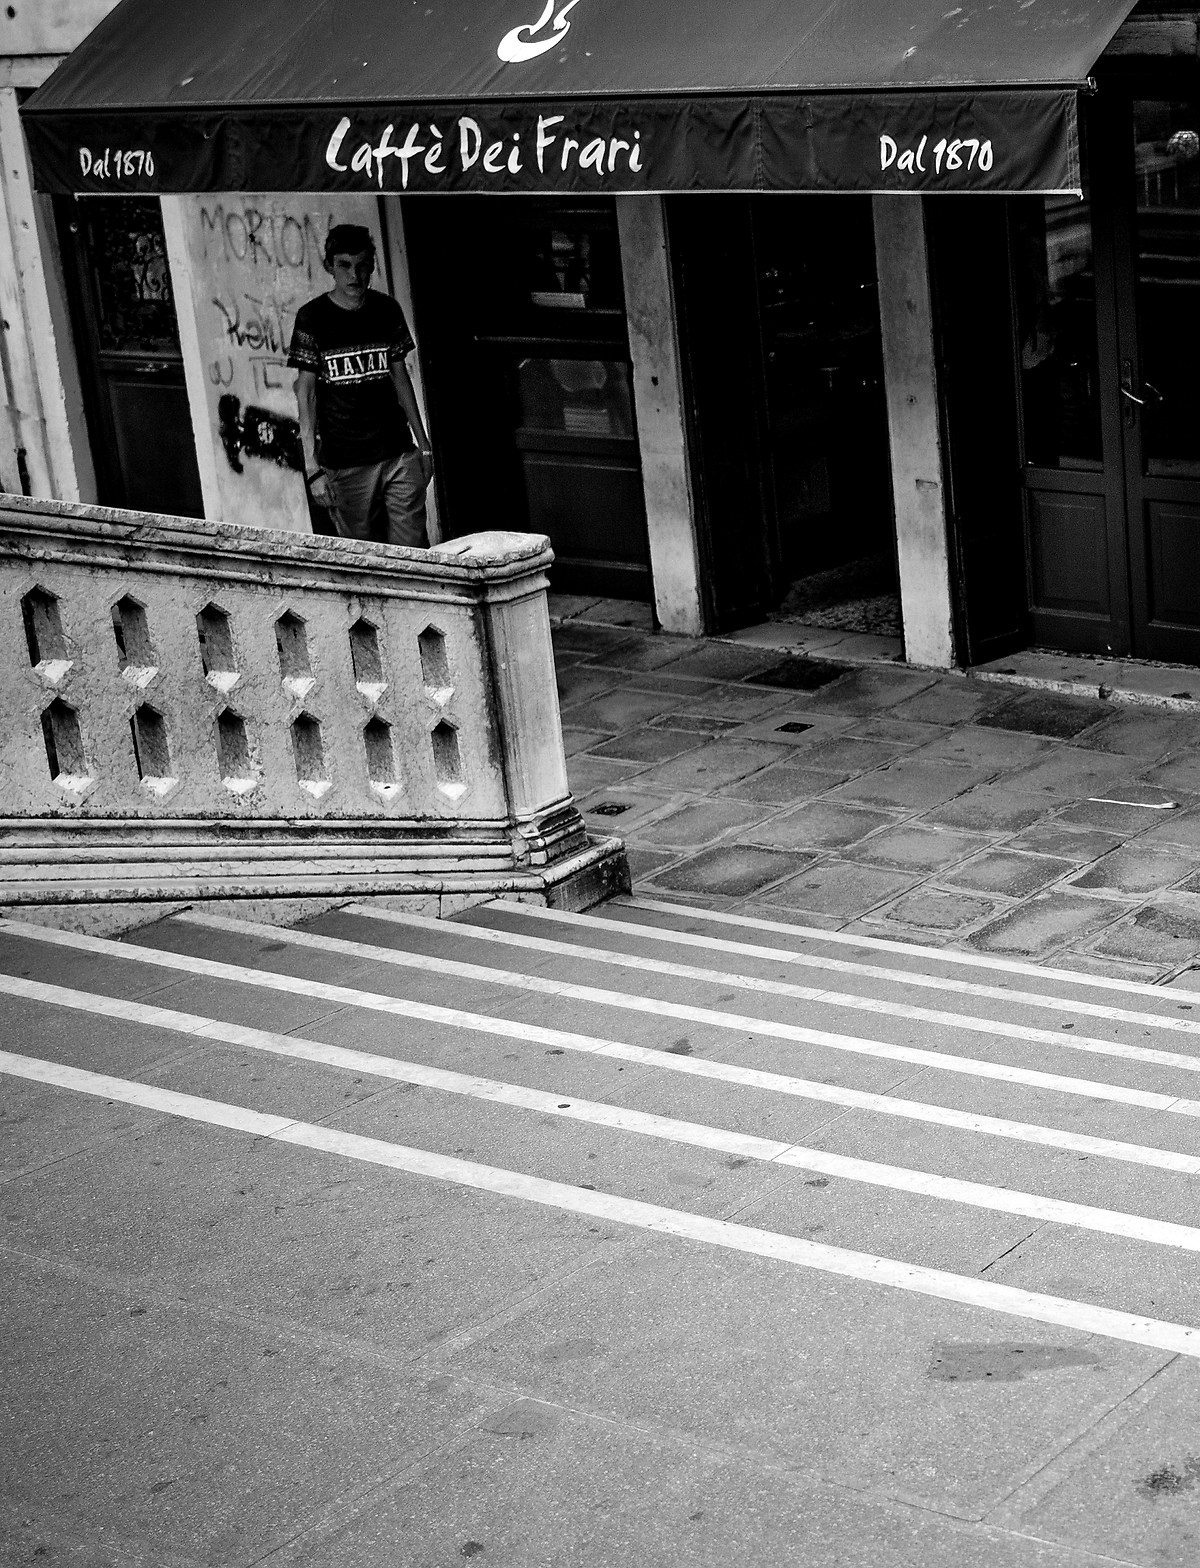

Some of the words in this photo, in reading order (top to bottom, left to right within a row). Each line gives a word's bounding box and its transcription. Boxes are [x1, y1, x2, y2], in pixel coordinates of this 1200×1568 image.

[79, 147, 111, 180] Dal
[113, 149, 155, 180] 1870
[325, 115, 447, 190] Caffè
[457, 115, 524, 175] Dei
[536, 114, 644, 177] Frari
[879, 134, 928, 175] Dal
[933, 138, 994, 175] 1870
